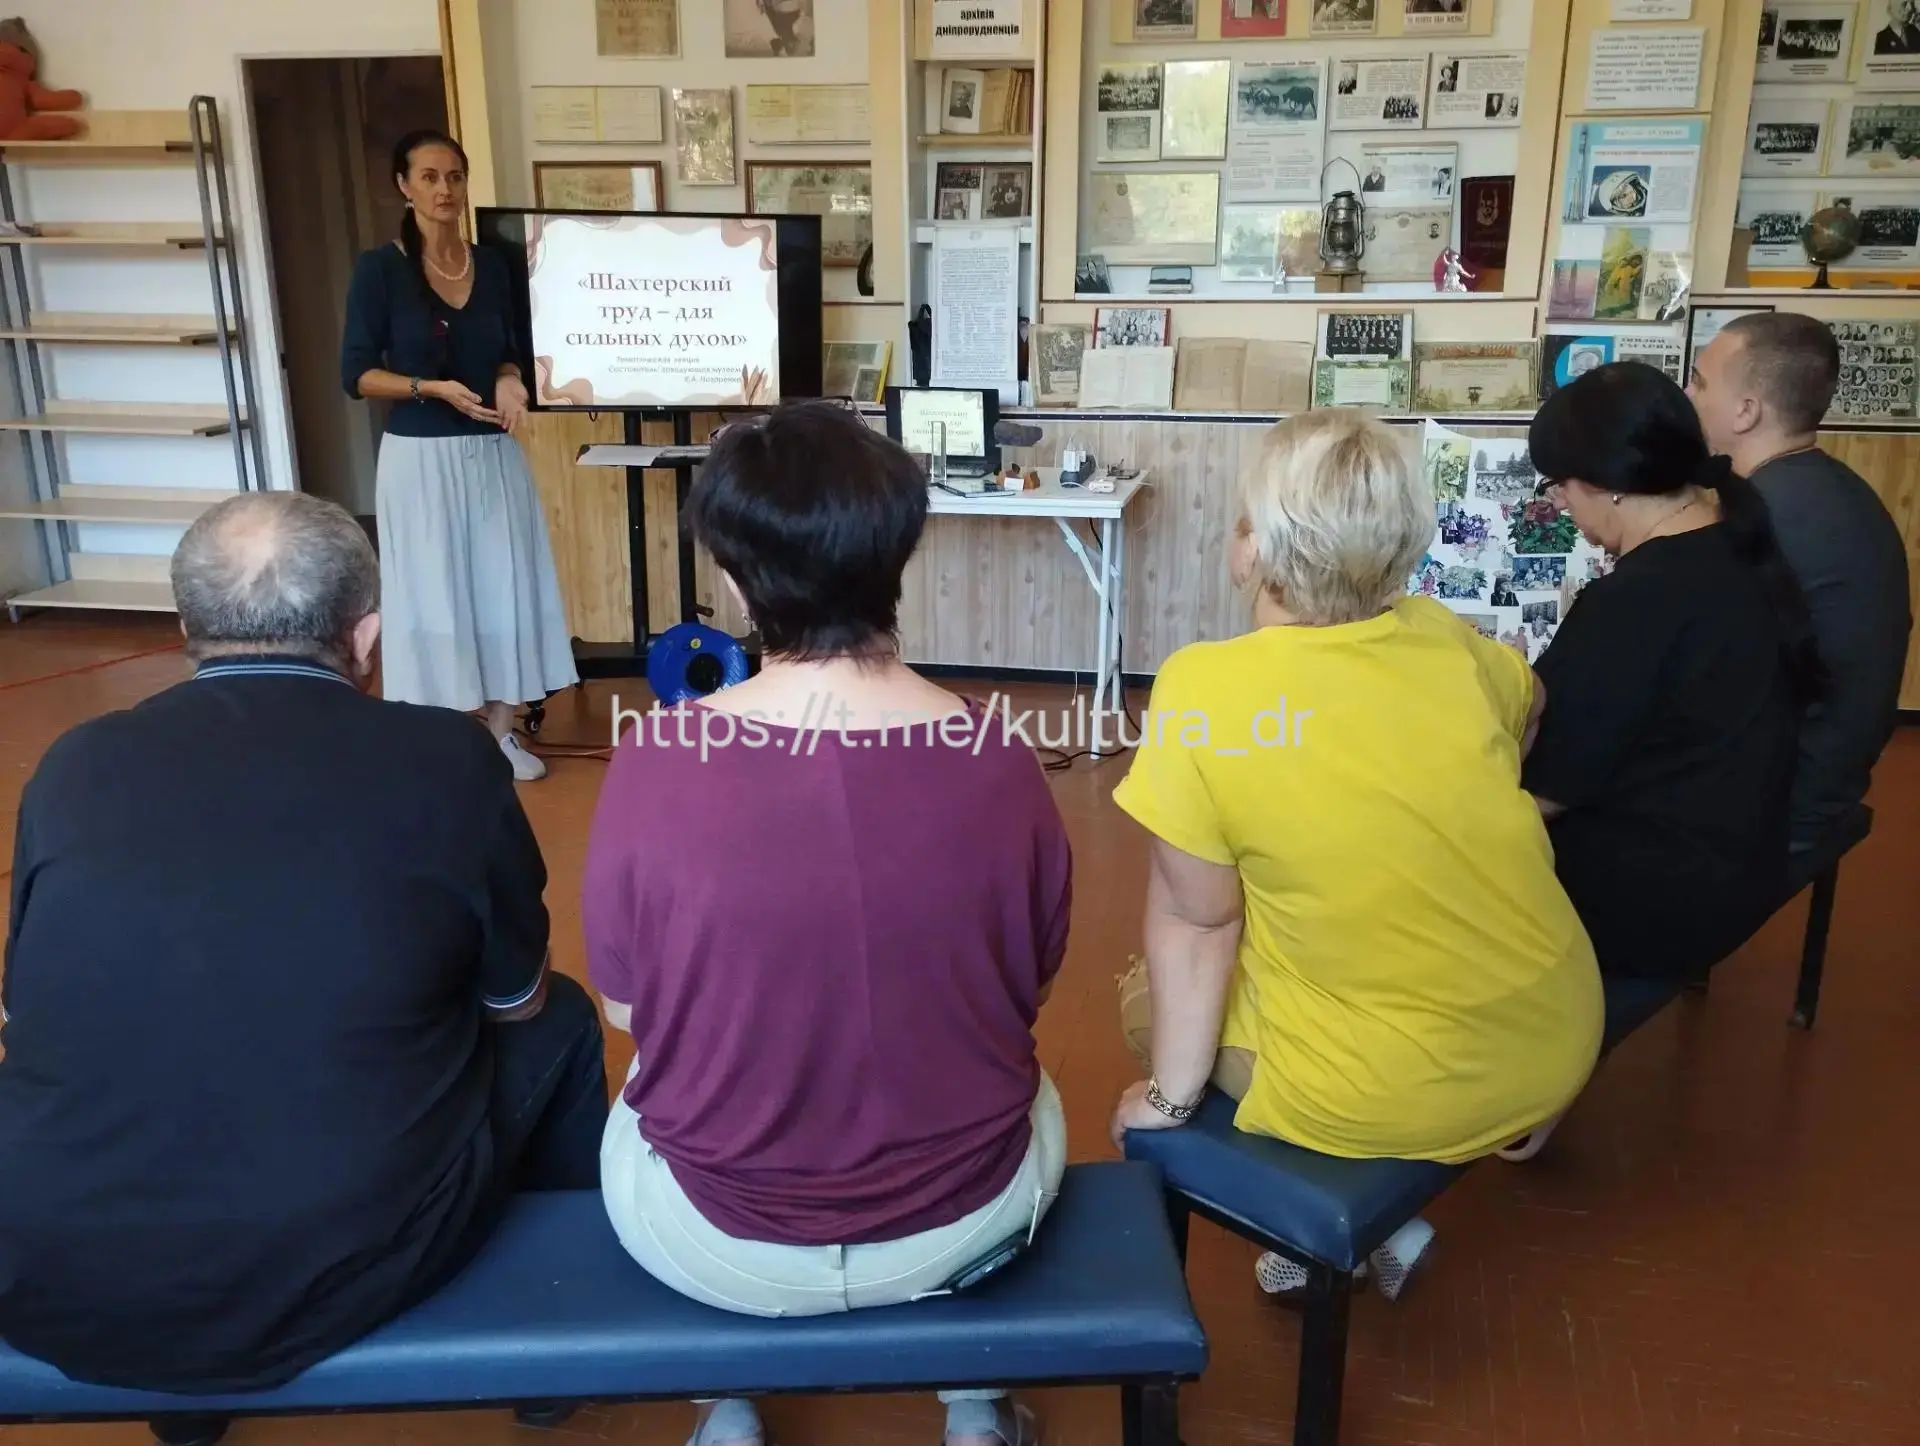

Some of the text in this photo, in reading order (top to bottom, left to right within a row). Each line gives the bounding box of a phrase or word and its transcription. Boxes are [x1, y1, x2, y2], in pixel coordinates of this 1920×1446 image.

[960, 8, 994, 21] архівів
[935, 24, 1020, 38] дніпрорудненців
[578, 272, 732, 298] «Шахтерский
[598, 305, 652, 325] труд
[675, 306, 714, 322] для
[565, 332, 747, 352] сильных духом»
